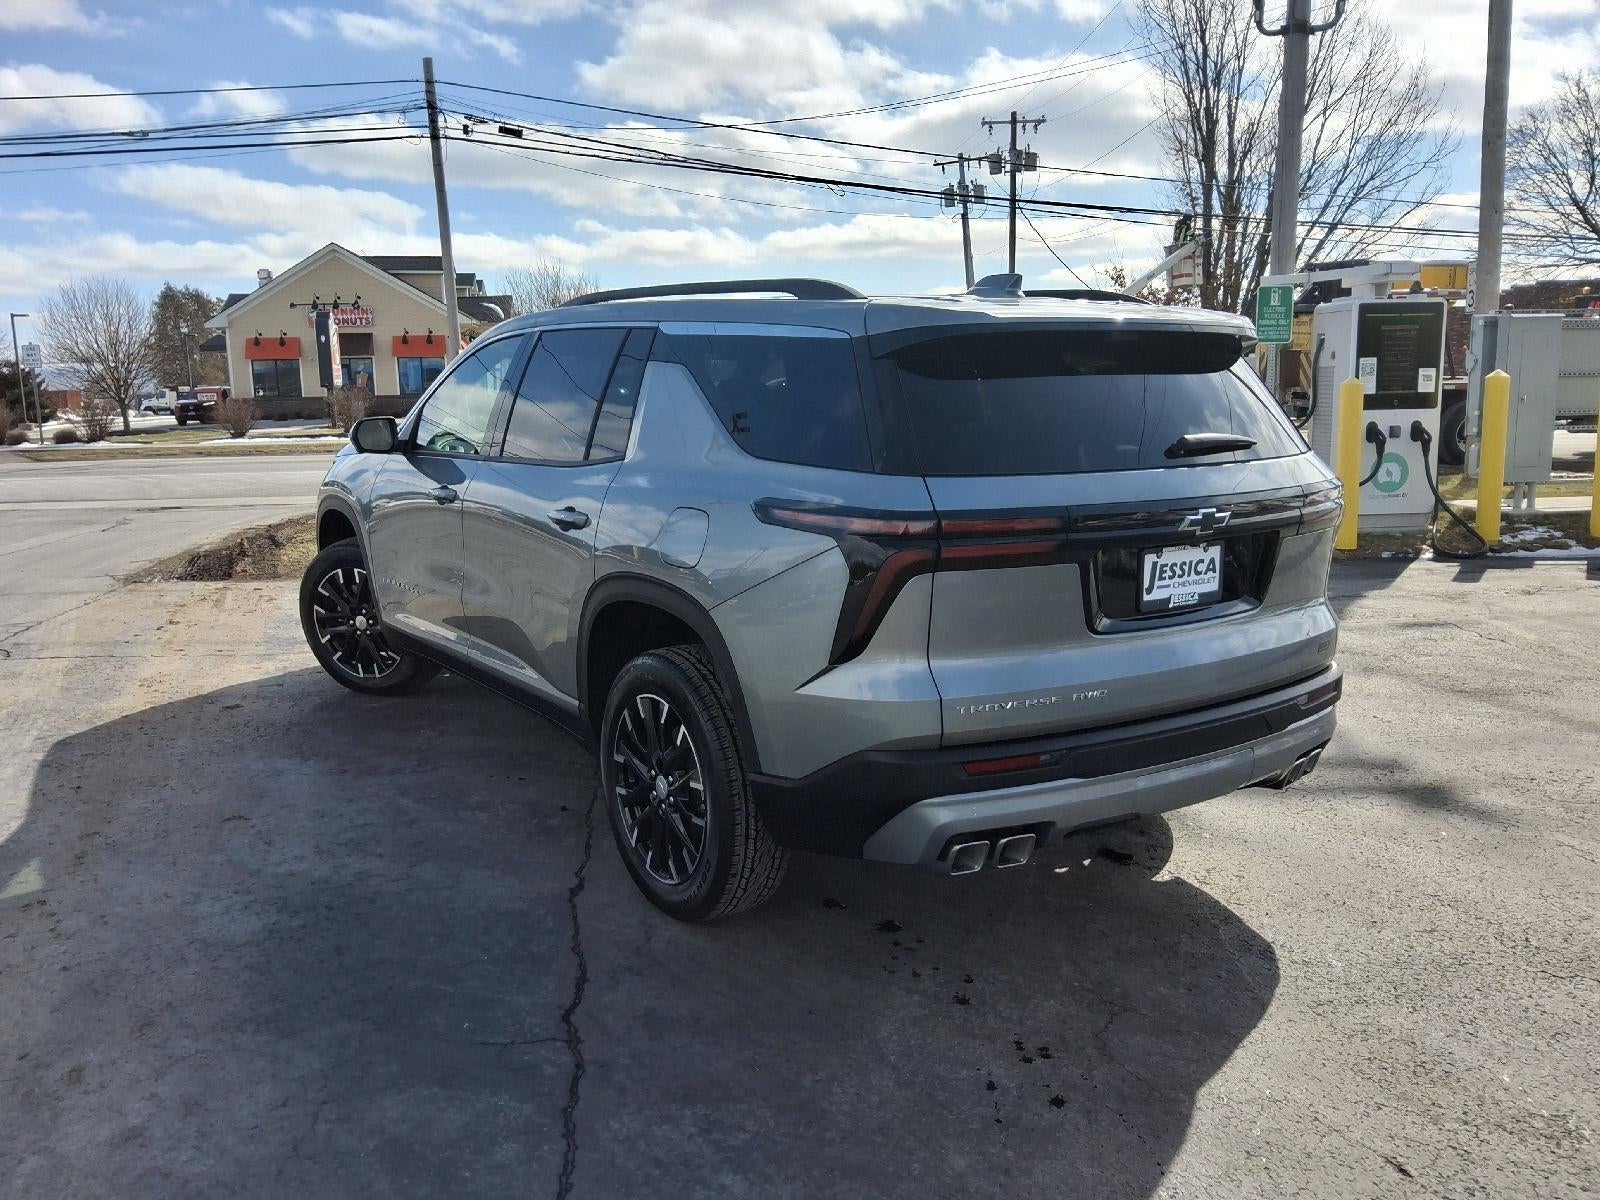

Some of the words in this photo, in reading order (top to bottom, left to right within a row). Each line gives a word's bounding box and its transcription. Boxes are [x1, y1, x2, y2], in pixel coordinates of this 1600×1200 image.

[334, 317, 371, 326] ONUTS
[1145, 557, 1217, 596] JESSICA
[1172, 575, 1217, 589] CHEVROLET
[1168, 592, 1199, 608] JESSICA
[956, 695, 1064, 715] TRAVERSE
[1072, 688, 1109, 701] AWD
